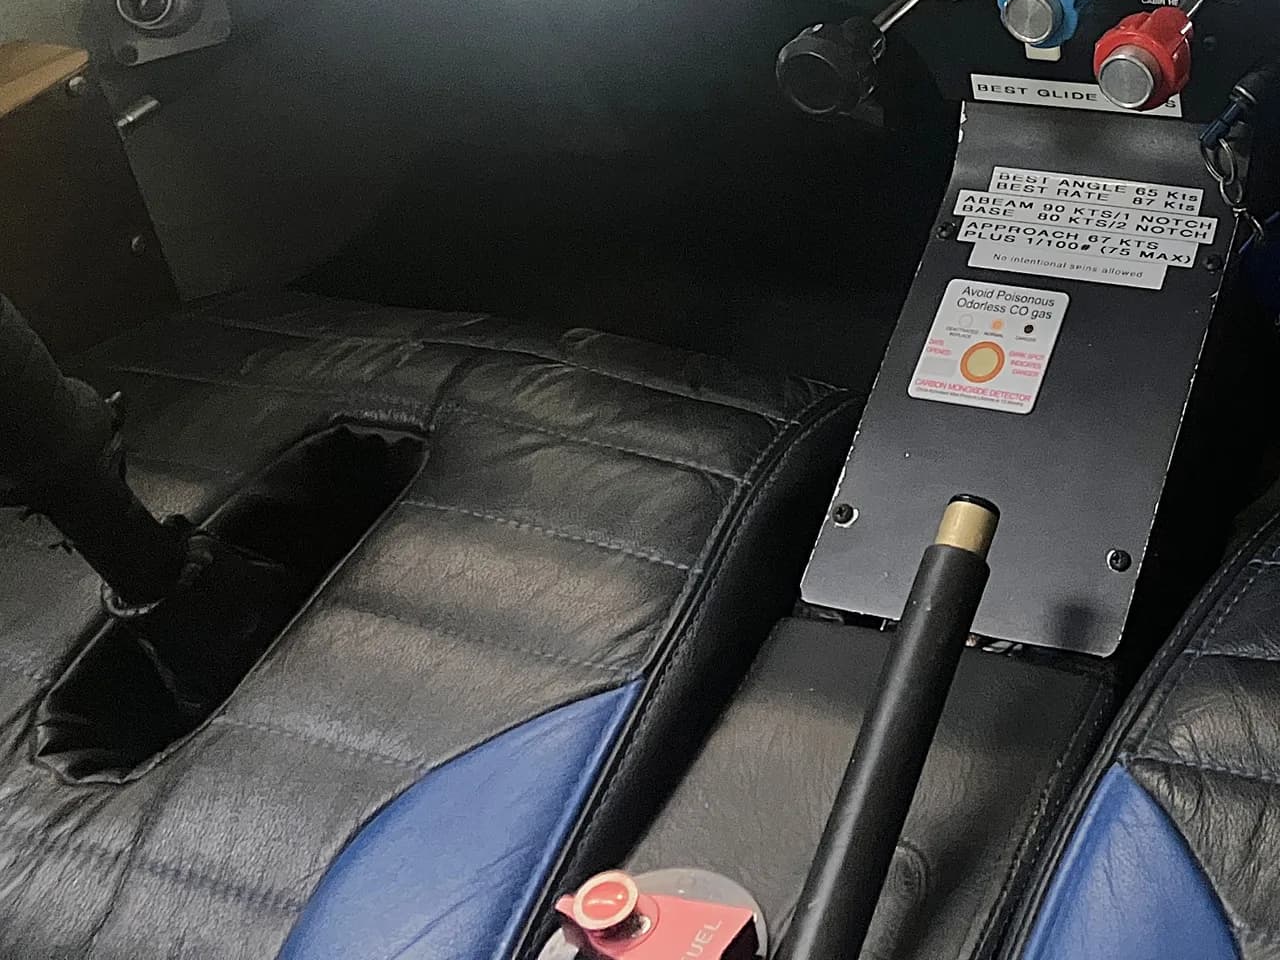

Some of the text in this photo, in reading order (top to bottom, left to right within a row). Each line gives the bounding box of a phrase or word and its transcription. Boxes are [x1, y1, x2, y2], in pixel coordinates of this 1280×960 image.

[977, 83, 1097, 101] BEST GLIDE
[996, 182, 1048, 194] BEST
[1056, 188, 1110, 201] RATE
[1132, 197, 1155, 206] 87
[999, 173, 1047, 185] BEST
[1059, 179, 1128, 194] ANGLE
[1135, 187, 1158, 197] 65
[962, 204, 1207, 239] BASE 80 KTS/2 NOTCH
[964, 195, 1212, 230] ABEAM 90 KTS/1 NOTCH
[964, 230, 1191, 264] PLUS 1/100# (75 MAX)
[967, 221, 1159, 250] APPROACH 67 KTS
[993, 253, 1008, 261] No
[1010, 255, 1067, 269] intentional
[1101, 267, 1144, 278] allowed
[957, 297, 1053, 320] Odorless CO gas
[962, 286, 1056, 307] Avoid Poisonous
[915, 378, 947, 390] CARBON
[948, 383, 988, 395] MONOXIDE
[989, 389, 1032, 402] DETECTOR
